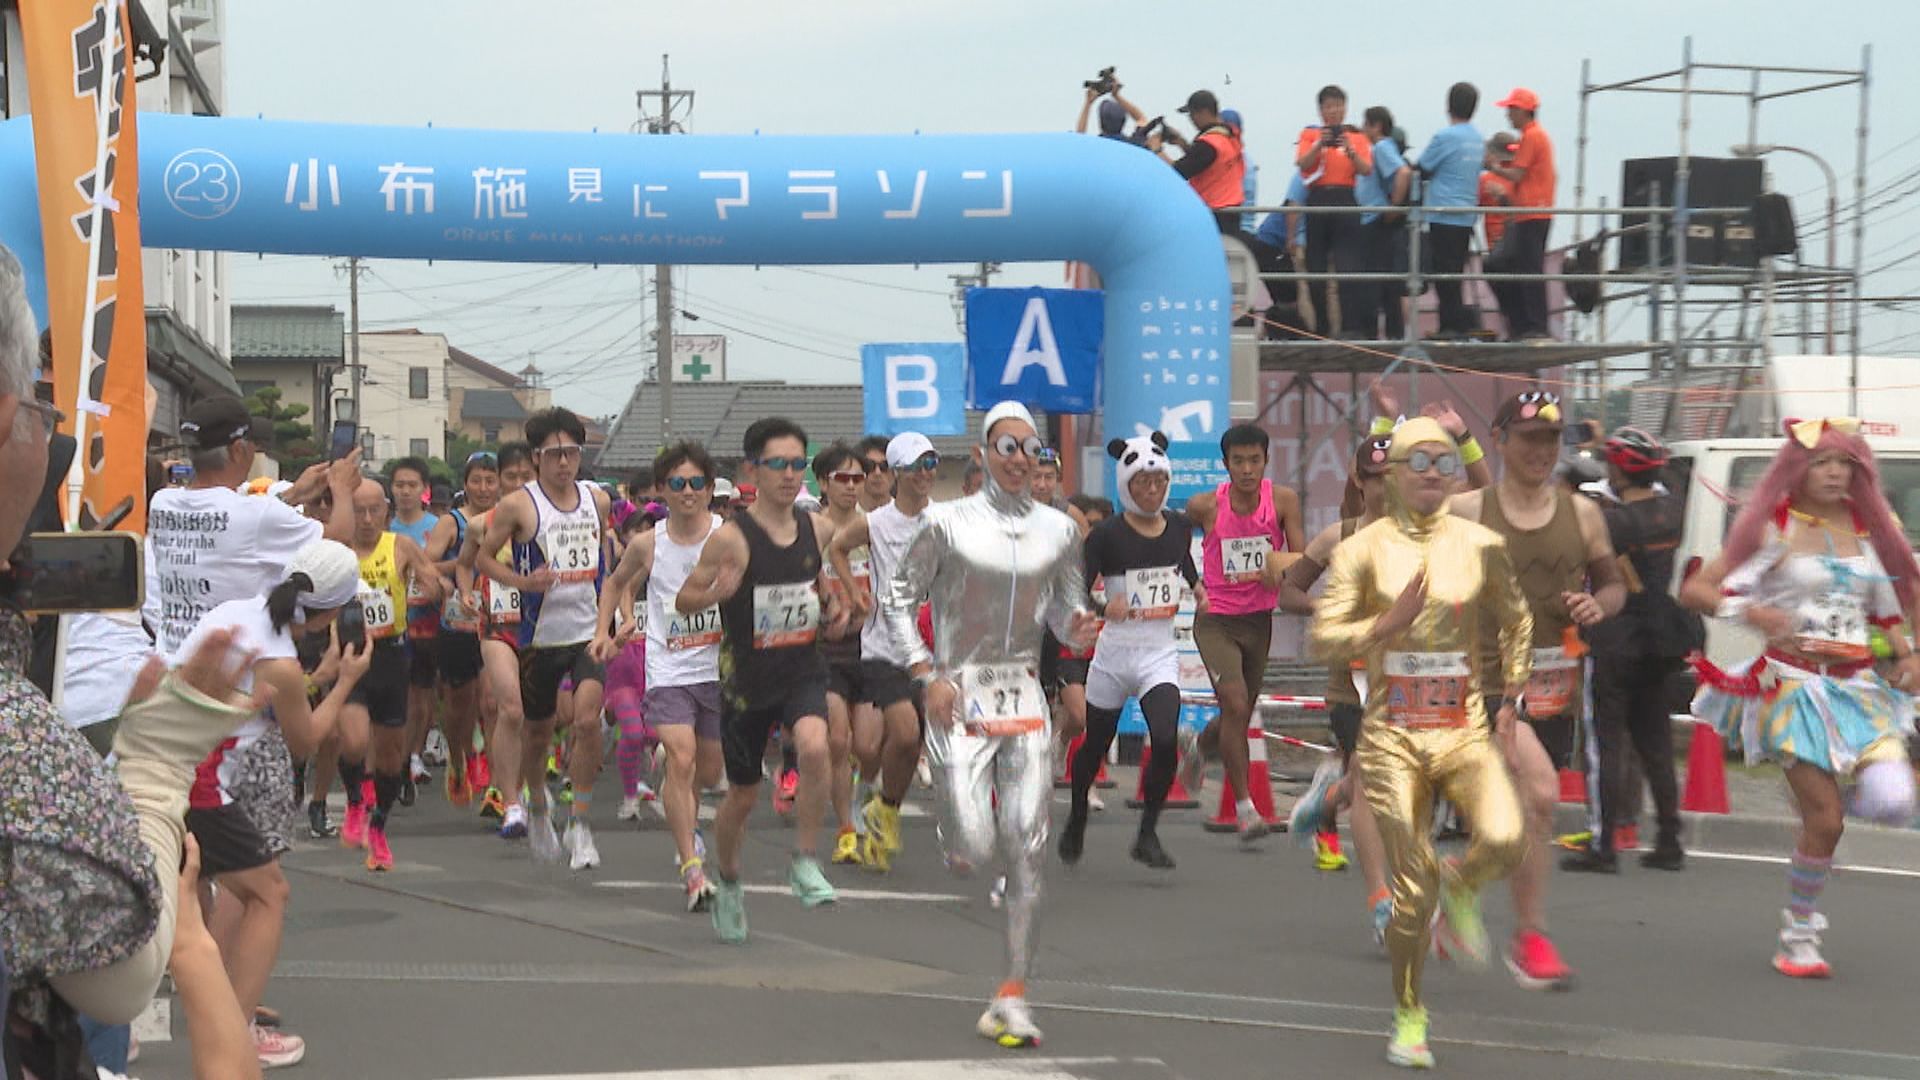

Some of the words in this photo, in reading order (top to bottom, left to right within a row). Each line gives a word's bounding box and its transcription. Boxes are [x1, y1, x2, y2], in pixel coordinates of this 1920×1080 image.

[173, 162, 229, 202] 23
[443, 227, 514, 242] OBUSE
[599, 232, 724, 247] MARATHON
[1140, 296, 1218, 313] obuse
[1142, 321, 1218, 336] mini
[1000, 297, 1068, 386] A
[885, 354, 939, 418] B
[568, 547, 590, 568] 33
[1226, 558, 1236, 571] A
[1242, 551, 1263, 570] 70
[493, 598, 503, 611] A
[1131, 592, 1142, 606] A
[1148, 584, 1171, 605] 78
[365, 604, 388, 625] 98
[670, 621, 680, 634] A
[684, 610, 716, 634] 107
[781, 603, 808, 628] 75
[994, 687, 1021, 715] 27
[1388, 685, 1408, 707] A
